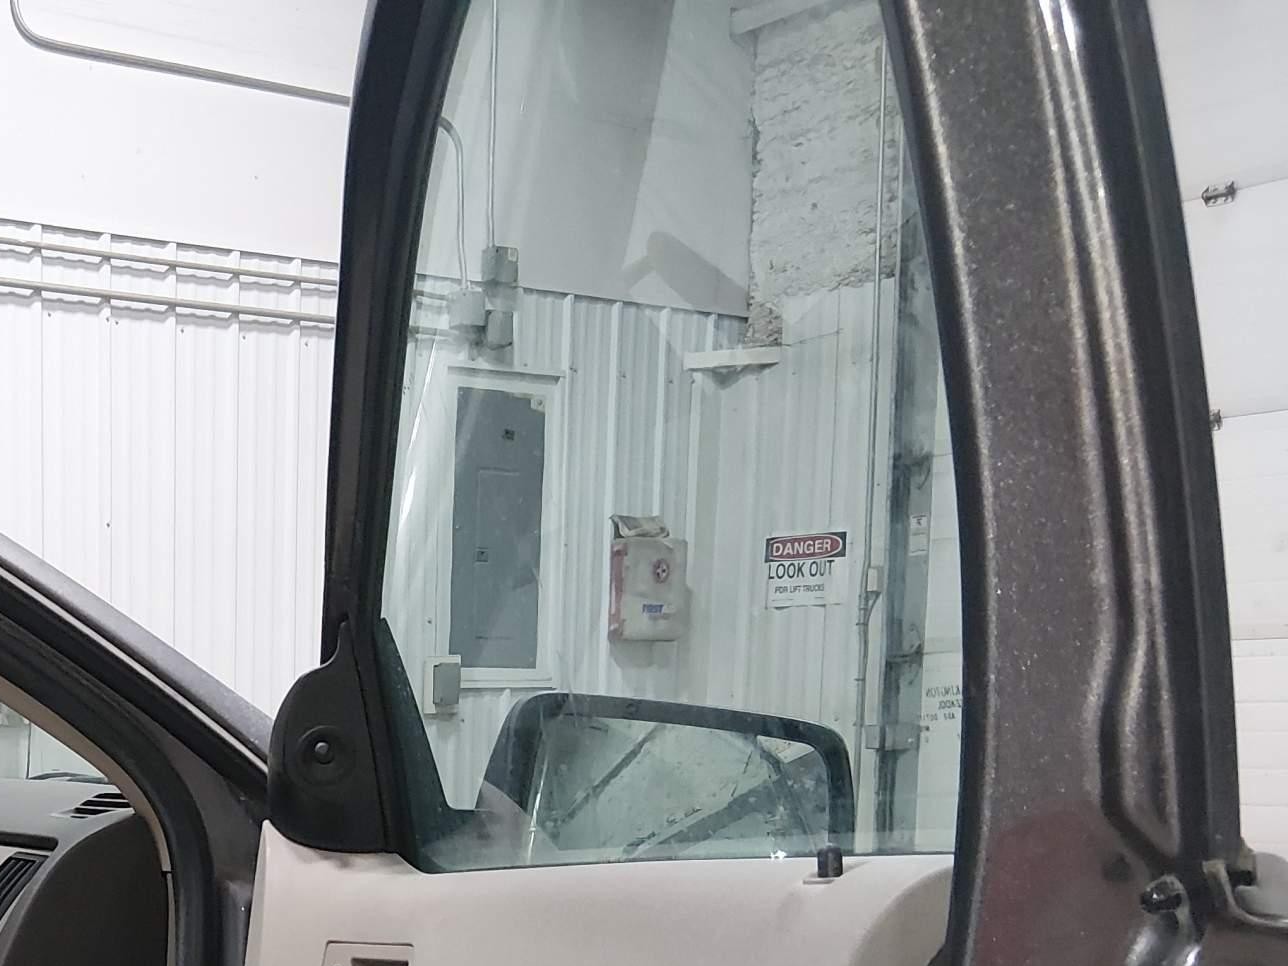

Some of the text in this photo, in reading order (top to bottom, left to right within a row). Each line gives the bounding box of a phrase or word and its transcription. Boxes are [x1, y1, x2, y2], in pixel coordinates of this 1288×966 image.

[772, 539, 832, 556] DANGER
[768, 560, 835, 580] LOOK OUT
[774, 583, 825, 594] FOR LIFT TRUCKS
